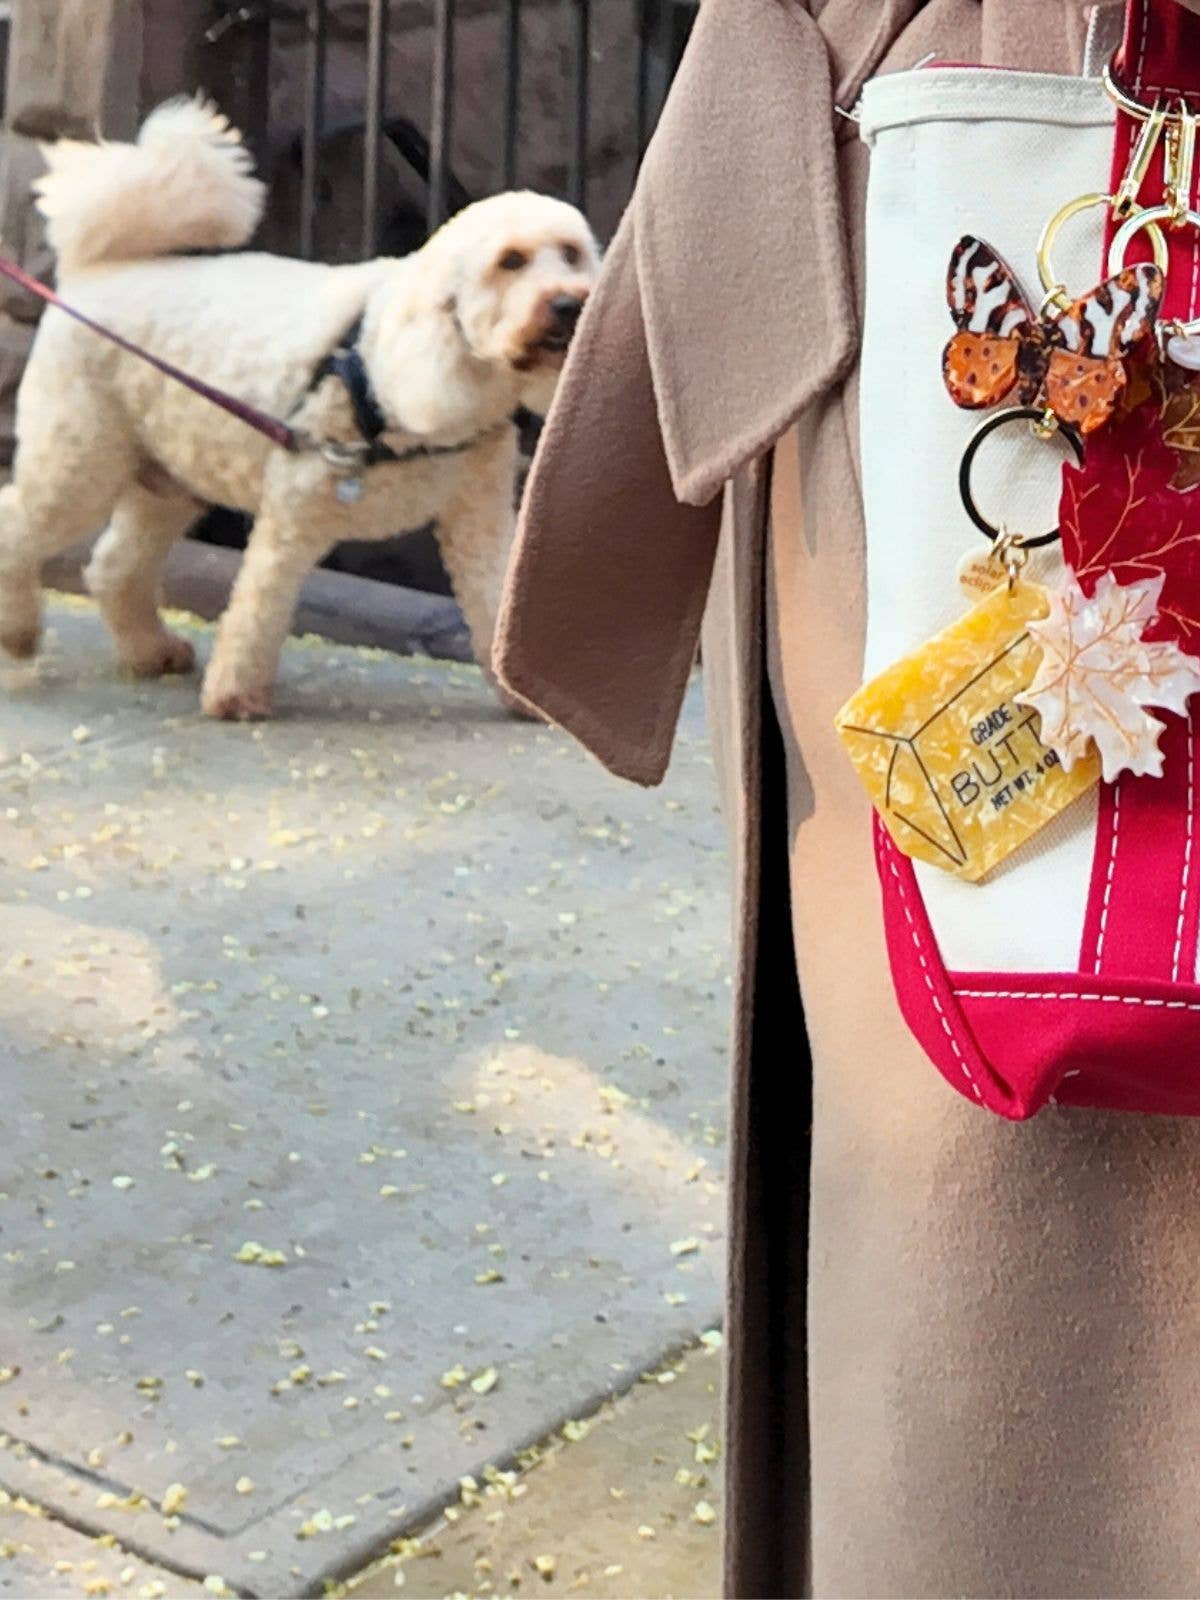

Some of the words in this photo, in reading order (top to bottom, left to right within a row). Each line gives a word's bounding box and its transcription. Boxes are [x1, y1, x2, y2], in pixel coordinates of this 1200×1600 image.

[970, 702, 1013, 746] GRADE
[950, 711, 1043, 807] BUTT
[990, 784, 1014, 812] NET
